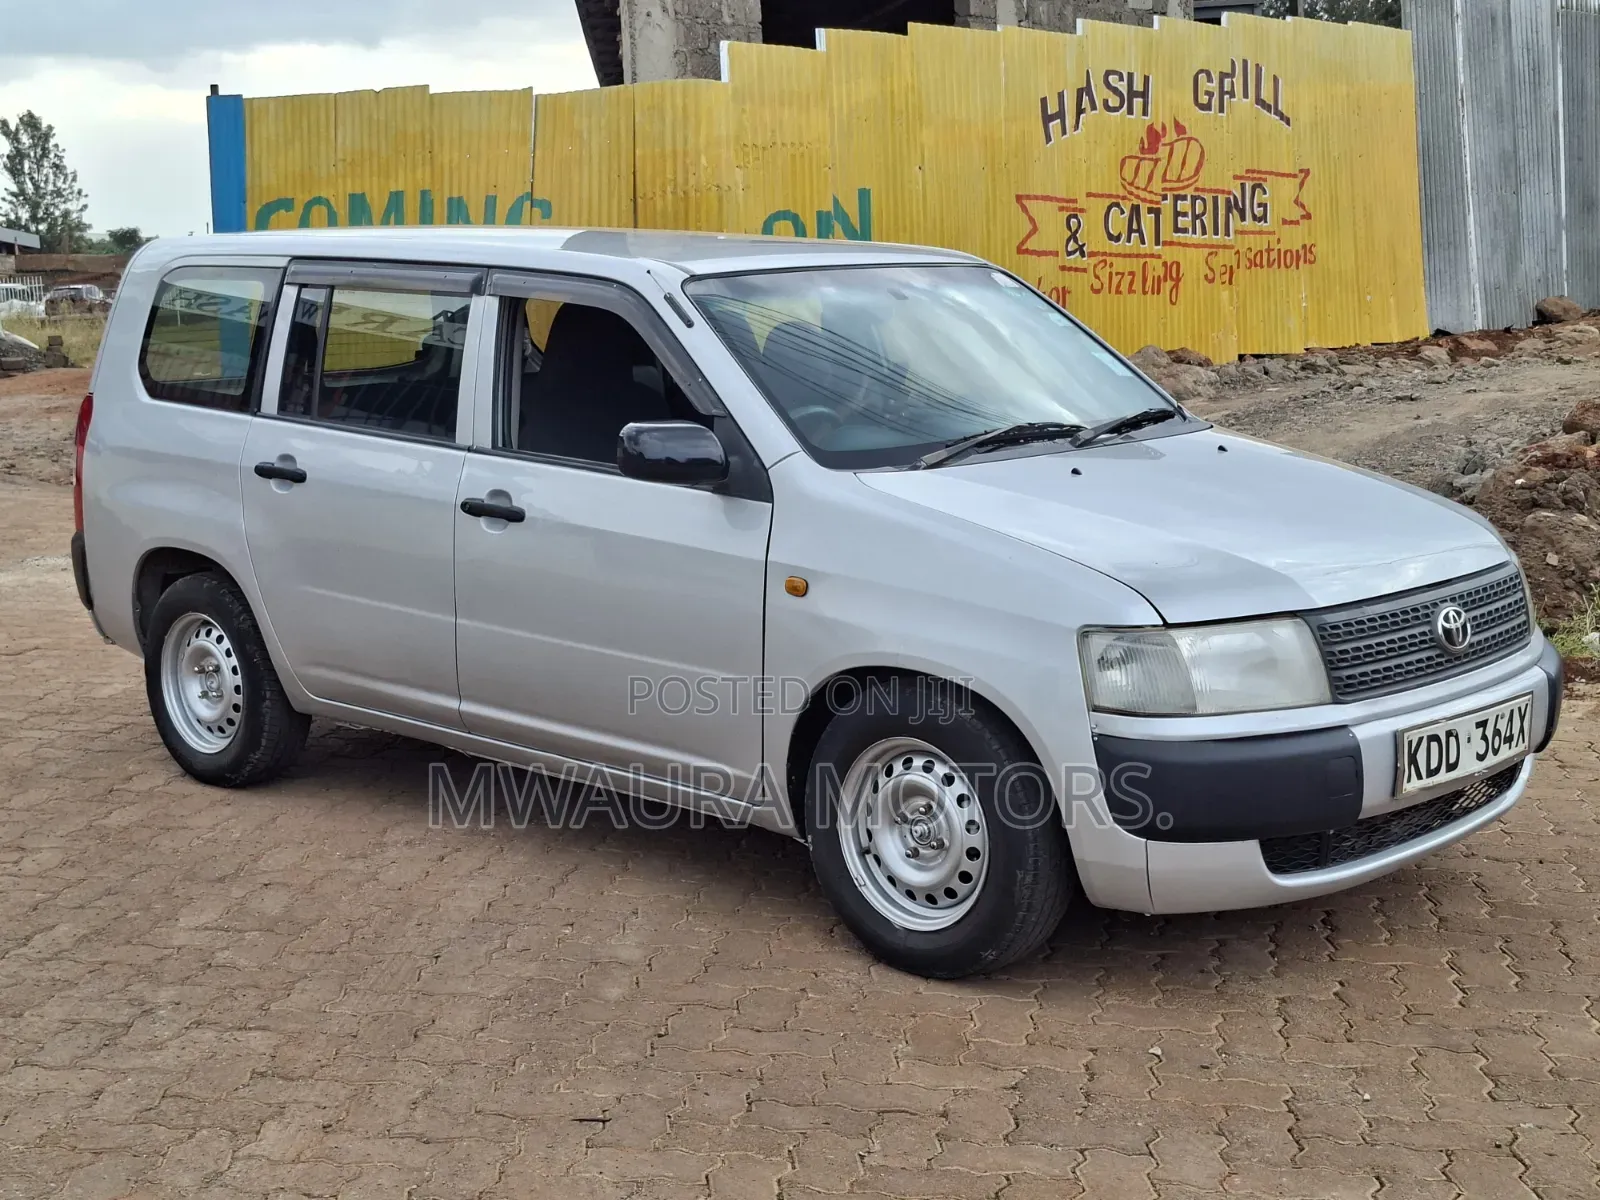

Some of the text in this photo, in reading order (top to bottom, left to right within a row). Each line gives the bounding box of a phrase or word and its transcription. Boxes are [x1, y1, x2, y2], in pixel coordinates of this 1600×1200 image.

[1040, 57, 1292, 146] HASH GRILL
[1064, 182, 1270, 260] & CATERING
[1089, 258, 1185, 306] Sizzling
[1203, 238, 1318, 286] Sensations
[1406, 703, 1529, 784] KDD 364X
